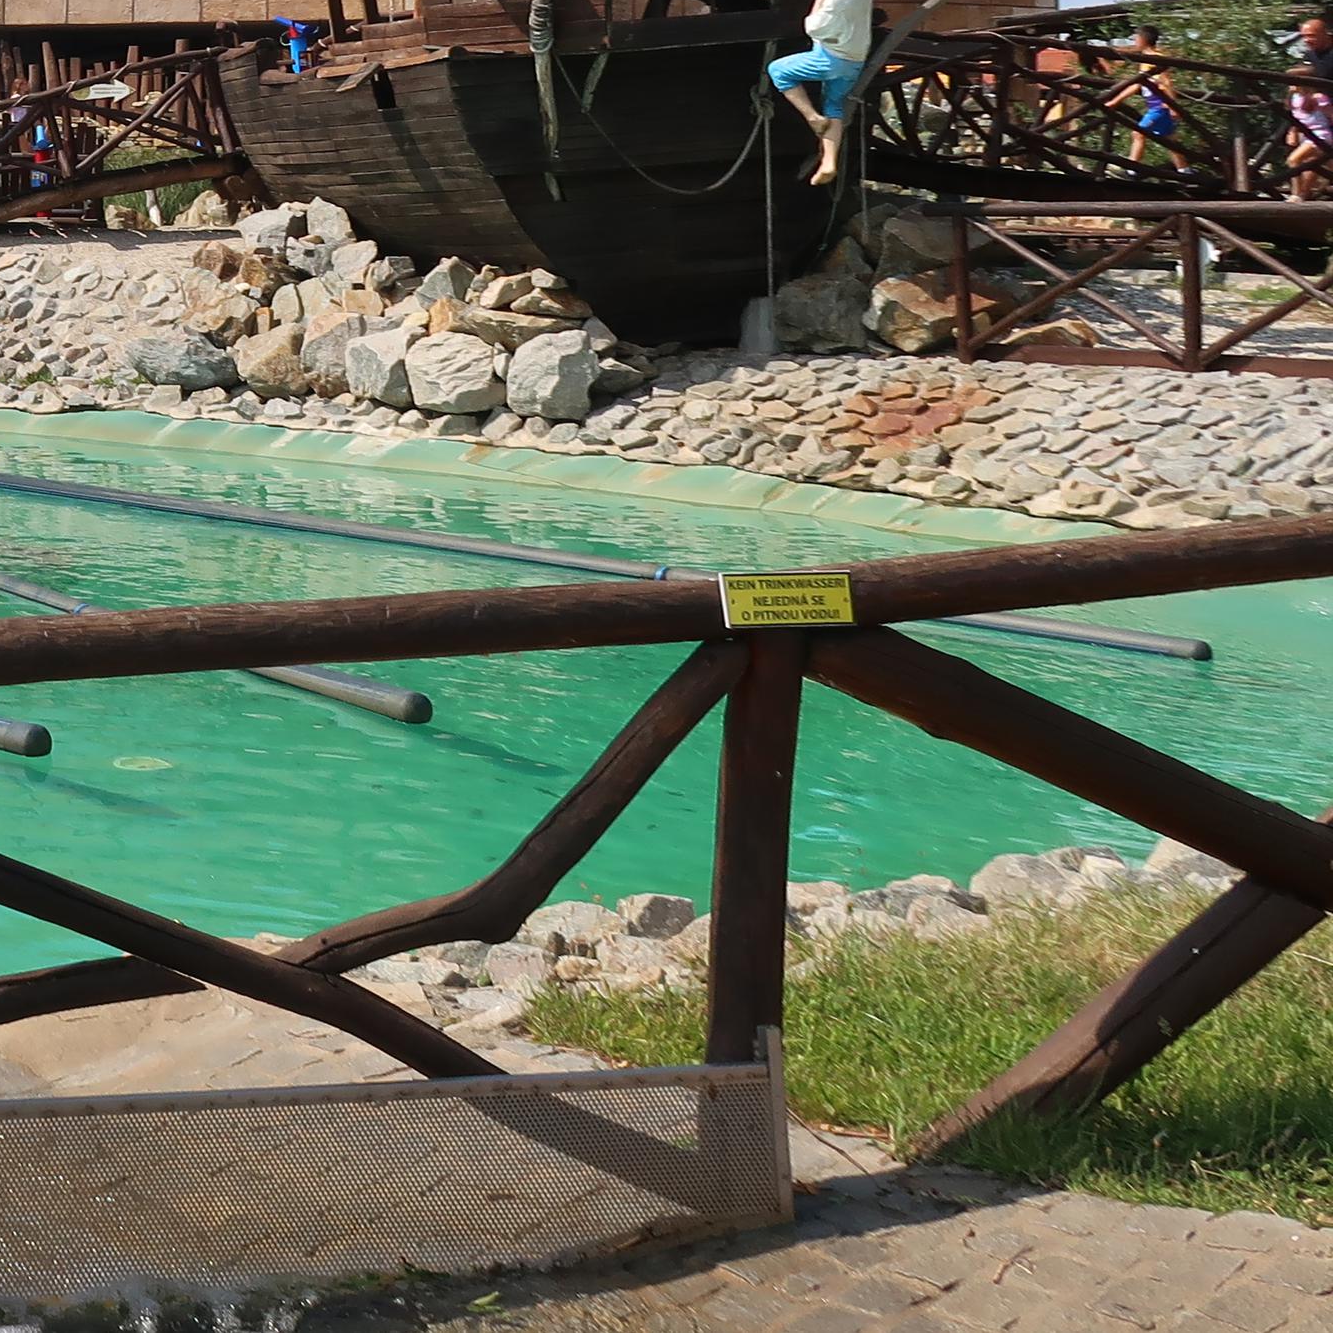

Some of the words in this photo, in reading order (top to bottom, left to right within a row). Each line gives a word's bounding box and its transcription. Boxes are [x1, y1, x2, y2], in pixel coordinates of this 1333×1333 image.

[728, 580, 756, 590] KEIN
[757, 578, 846, 590] TRINKWASSER!
[753, 593, 810, 606] NEJEDNÁ
[811, 595, 826, 605] SE
[741, 611, 751, 621] O
[753, 610, 800, 620] PITNOU
[801, 609, 840, 619] VODU!
